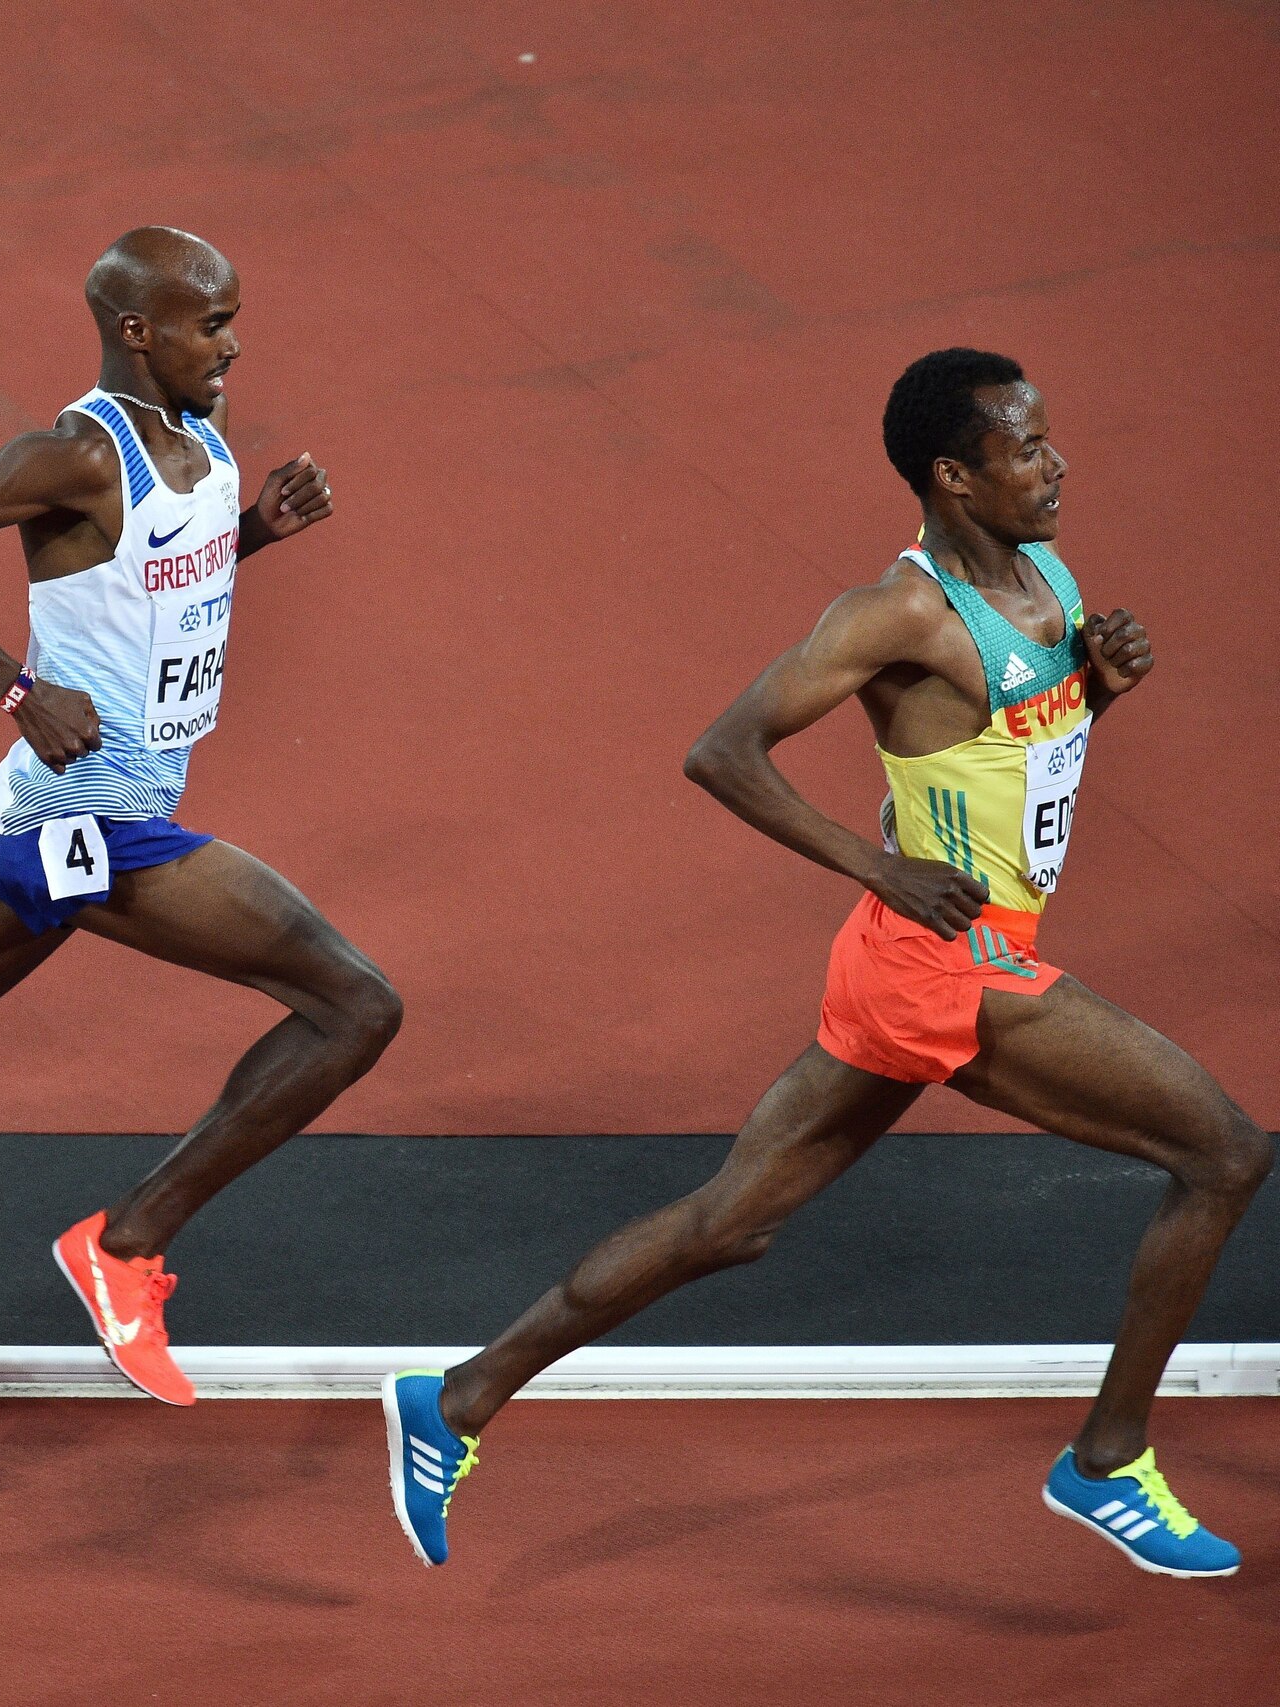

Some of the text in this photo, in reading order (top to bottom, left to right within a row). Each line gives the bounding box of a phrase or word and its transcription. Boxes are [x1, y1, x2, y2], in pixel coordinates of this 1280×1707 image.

[144, 548, 203, 593] GREAT
[1001, 669, 1037, 692] adidas
[151, 707, 214, 743] LONDON
[1004, 667, 1087, 740] ETHIO
[65, 828, 95, 876] 4
